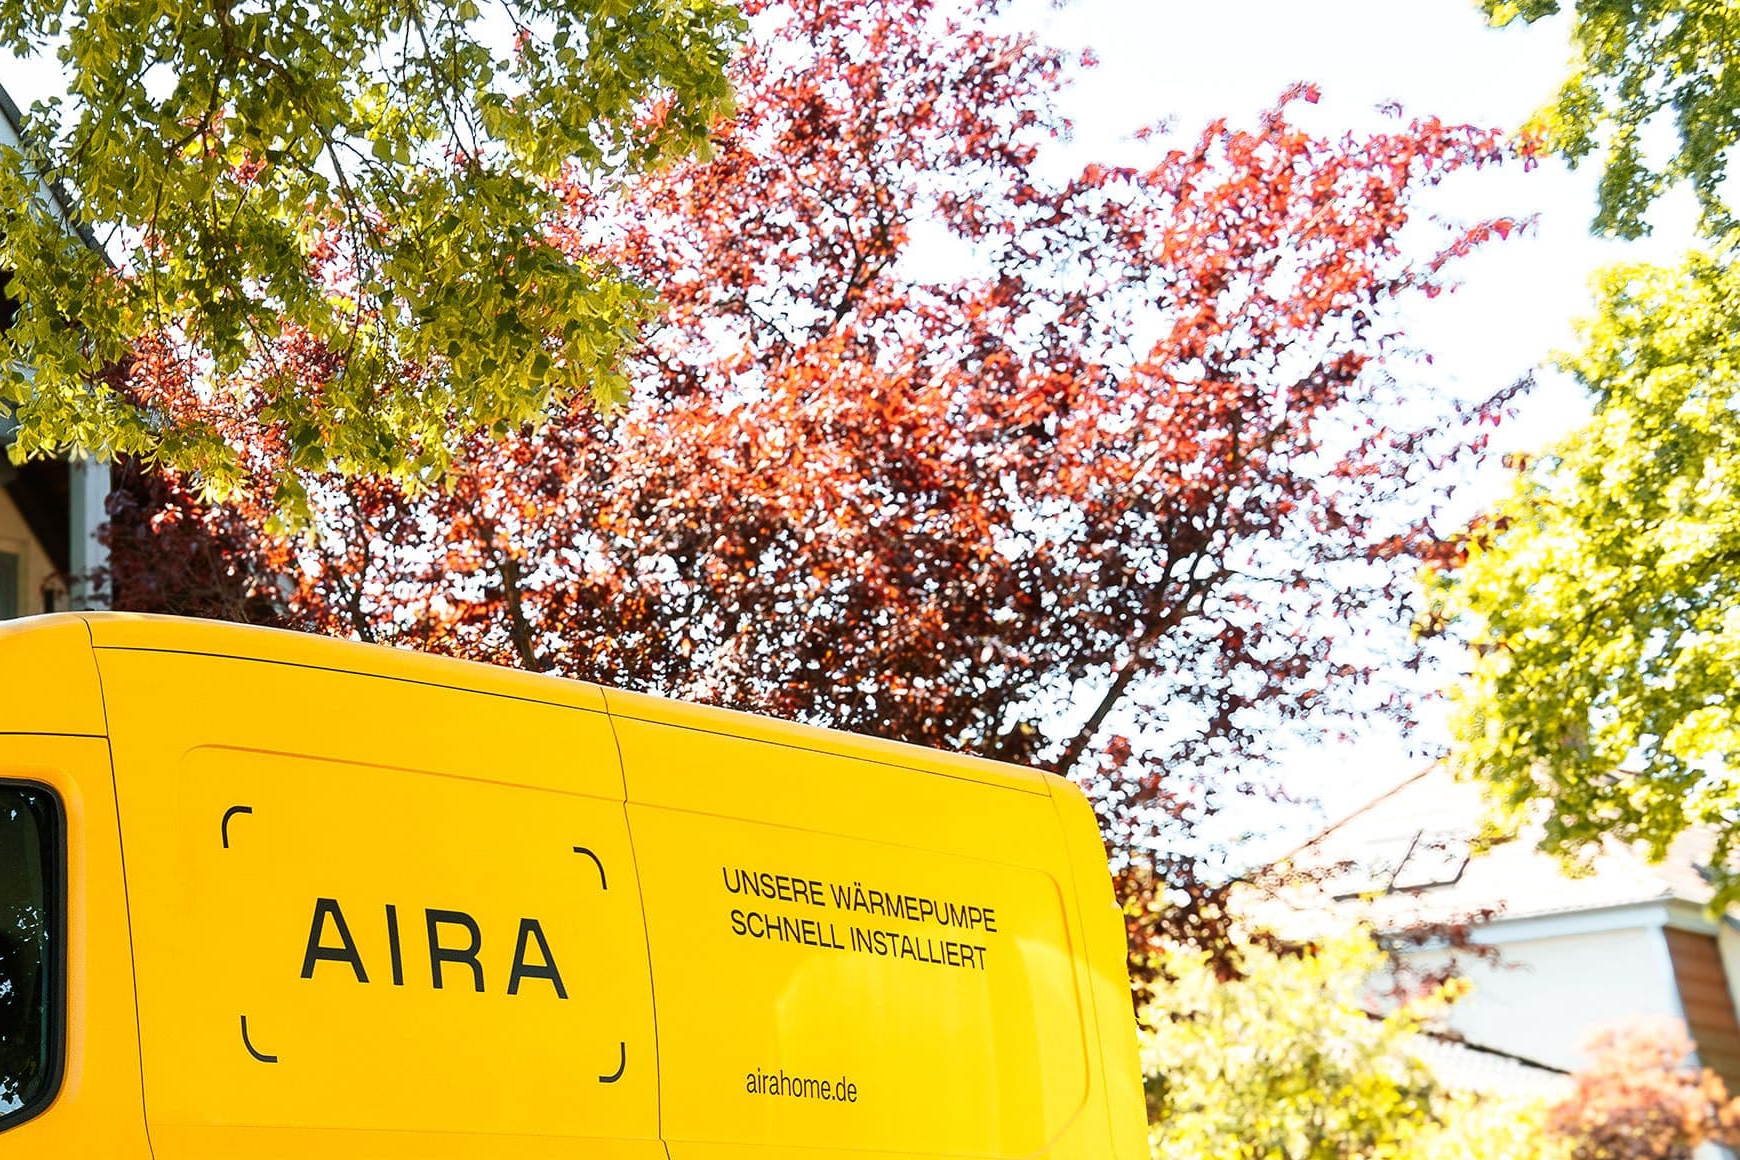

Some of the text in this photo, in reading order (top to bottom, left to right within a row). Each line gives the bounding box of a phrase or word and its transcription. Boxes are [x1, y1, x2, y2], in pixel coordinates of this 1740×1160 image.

[722, 866, 997, 933] UNSERE WÄRMEPUMPE
[300, 897, 569, 999] AIRA
[730, 909, 987, 970] SCHNELL INSTALLIERT
[746, 1067, 858, 1102] airahome.de
